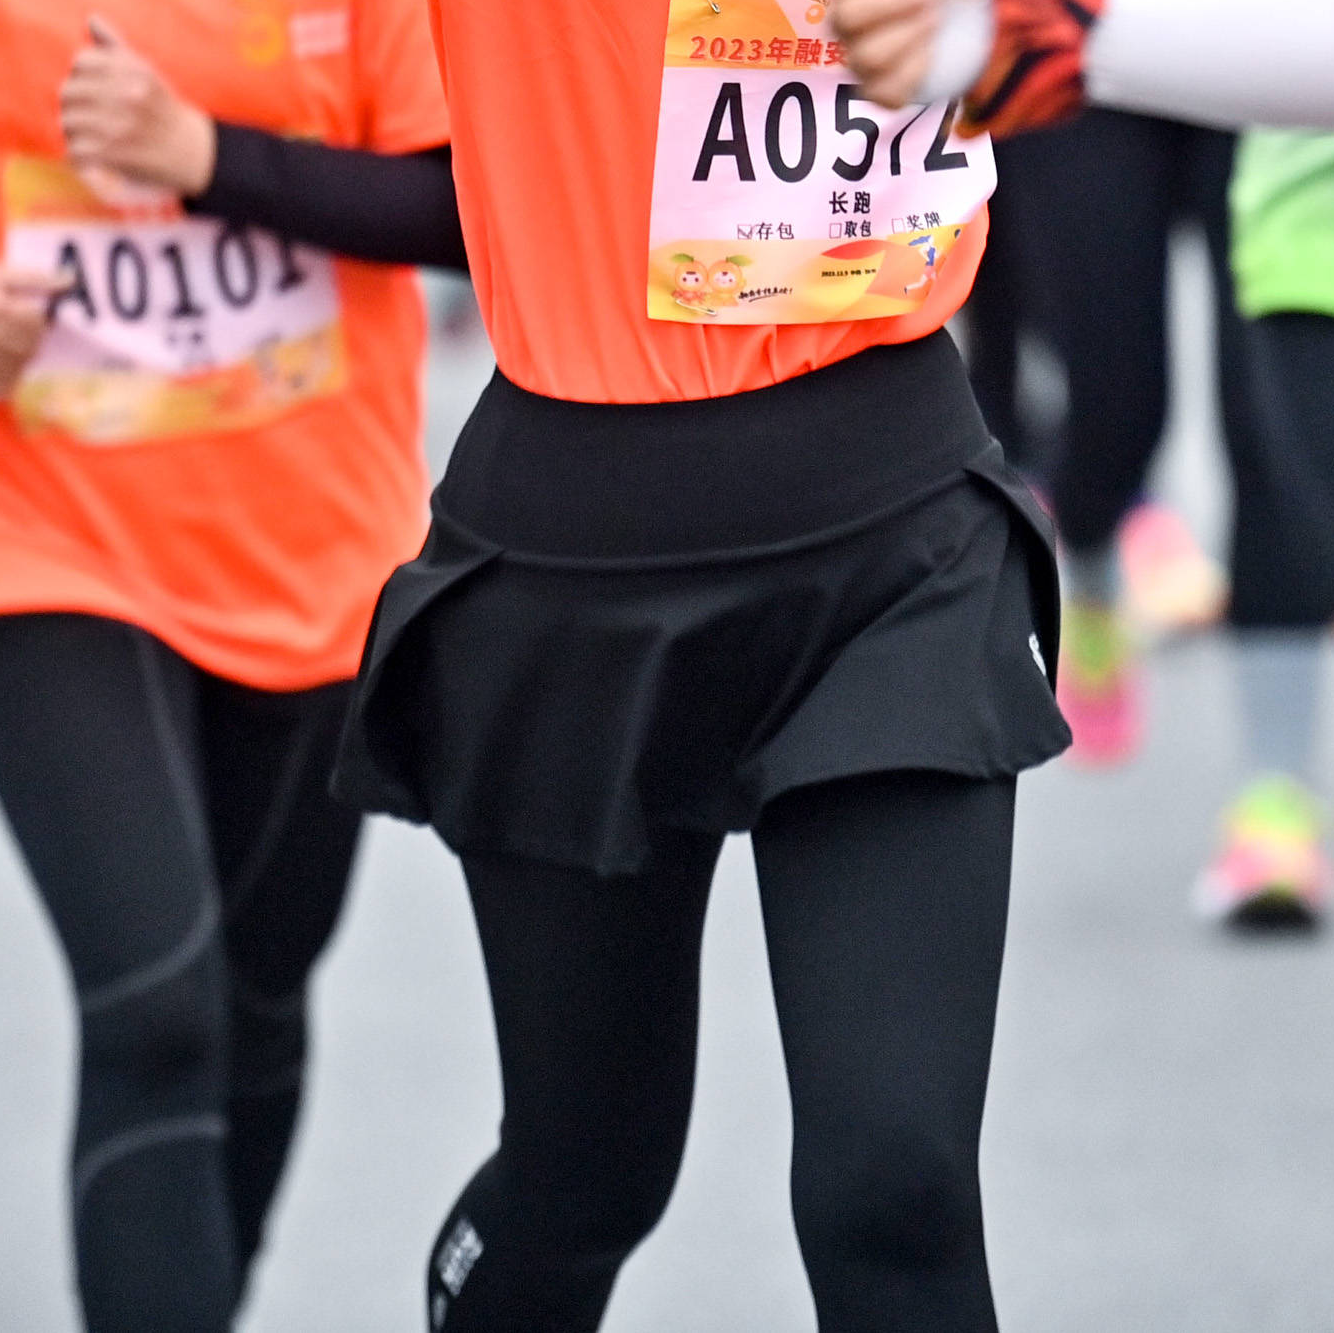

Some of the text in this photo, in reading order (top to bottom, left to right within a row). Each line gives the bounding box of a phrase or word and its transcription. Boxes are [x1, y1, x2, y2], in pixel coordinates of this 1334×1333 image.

[829, 191, 871, 215] 长跑
[757, 222, 795, 240] 存包
[844, 219, 872, 238] 取包
[907, 211, 942, 232] 奖牌
